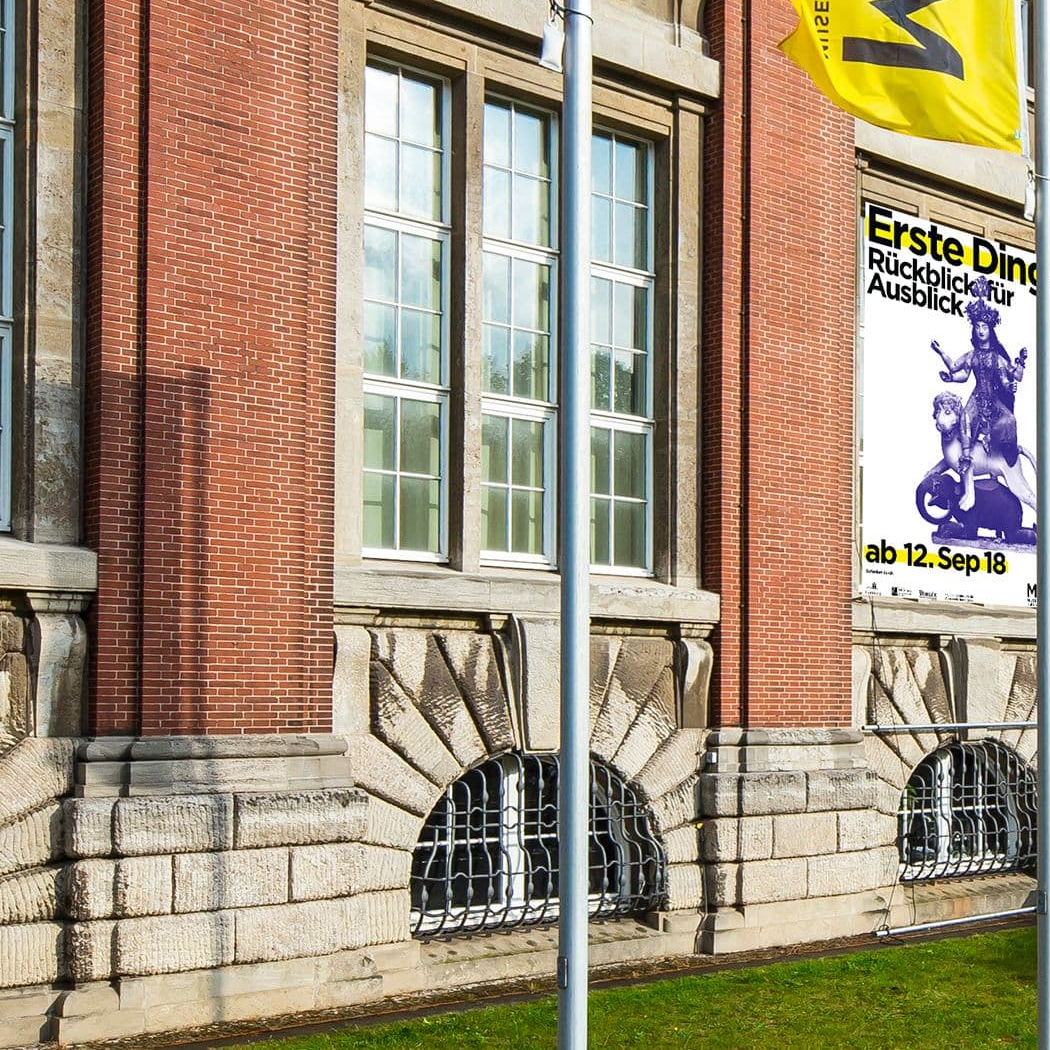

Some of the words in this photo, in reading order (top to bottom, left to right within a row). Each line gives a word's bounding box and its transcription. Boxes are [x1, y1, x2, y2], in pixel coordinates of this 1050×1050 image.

[869, 205, 964, 266] Erste
[867, 272, 965, 318] Ausblick
[869, 248, 976, 298] Rückblick
[987, 279, 1015, 307] für
[865, 539, 897, 565] ab
[904, 543, 934, 569] 12.
[938, 546, 980, 577] Sep
[984, 551, 1007, 575] 18
